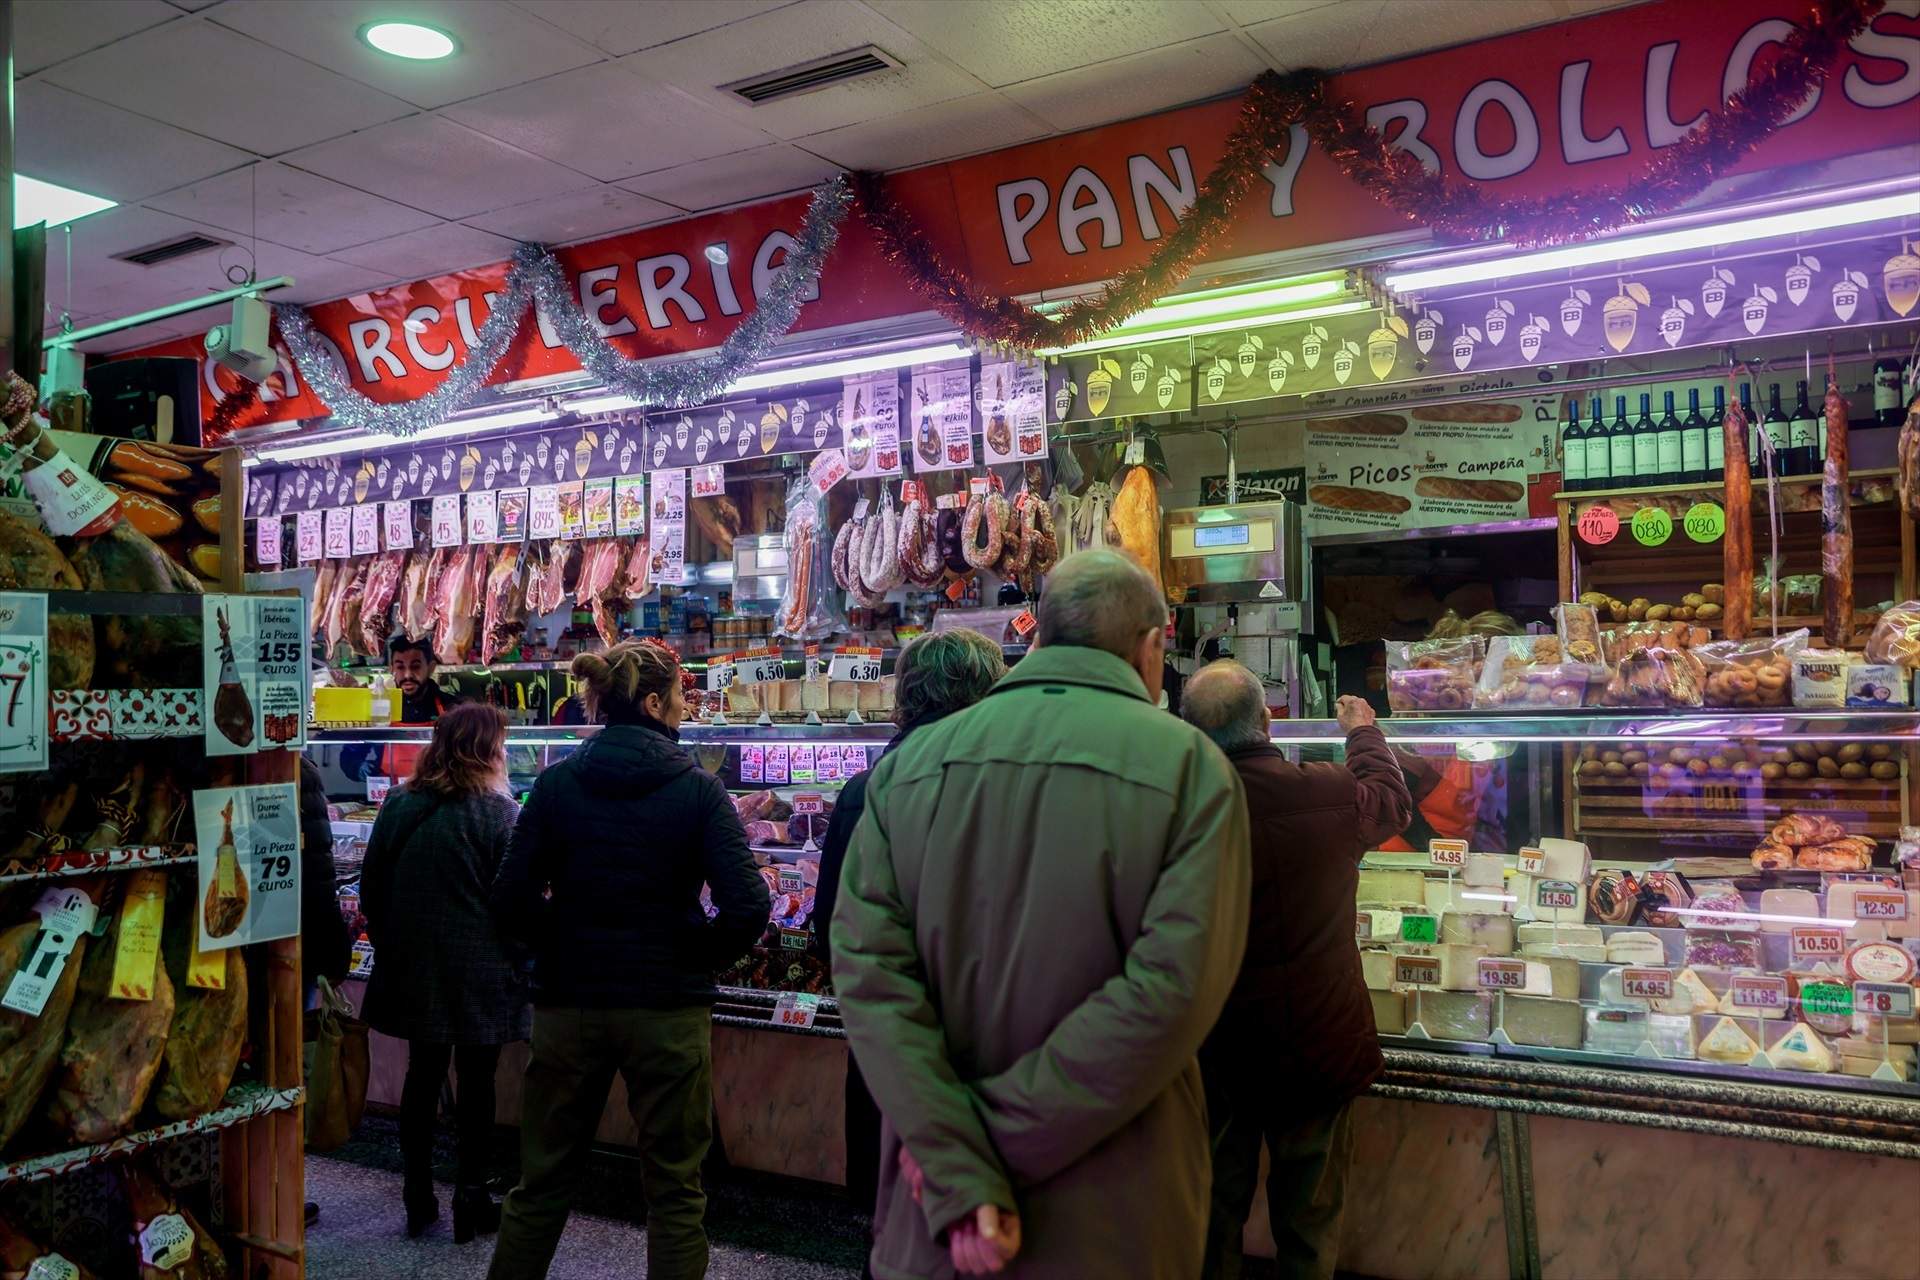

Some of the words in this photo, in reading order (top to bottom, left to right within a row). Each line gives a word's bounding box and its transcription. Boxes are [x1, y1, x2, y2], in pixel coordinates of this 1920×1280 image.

[997, 145, 1197, 264] PAN
[1262, 123, 1309, 217] Y
[1790, 279, 1808, 290] EB
[1705, 292, 1723, 303] EB
[1836, 295, 1855, 306] EB
[1564, 311, 1580, 321] EB
[1746, 310, 1764, 319] EB
[1488, 321, 1504, 331] EB
[1418, 331, 1433, 340] EB
[1523, 338, 1539, 347] EB
[1305, 346, 1319, 355] EB
[1455, 348, 1471, 356] EB
[1241, 355, 1254, 363] EB
[1336, 361, 1350, 370] EB
[1133, 372, 1145, 381] EB
[1271, 370, 1285, 379] EB
[1209, 378, 1223, 387] EB
[1159, 388, 1172, 396] EB
[1350, 463, 1411, 486] Picos
[1458, 457, 1524, 474] Campeña
[390, 523, 401, 542] 18
[437, 523, 451, 540] 15
[473, 519, 485, 535] 12
[330, 533, 344, 549] 22
[357, 530, 370, 545] 20
[264, 614, 290, 624] Ibérico
[260, 630, 271, 640] La
[274, 630, 298, 640] Pieza
[258, 643, 301, 662] 155
[756, 665, 784, 681] 6.50
[850, 665, 878, 680] 6.30
[717, 672, 733, 688] 5.50
[255, 844, 266, 855] La
[270, 842, 296, 854] Pieza
[1433, 850, 1461, 863] 14.95
[261, 856, 291, 879] 79
[1525, 859, 1535, 870] 14
[782, 880, 798, 889] 15.95
[1543, 893, 1571, 905] 11.50
[1864, 902, 1895, 915] 12.50
[1798, 938, 1838, 950] 10.50
[1402, 969, 1412, 980] 17
[1422, 970, 1432, 981] 18
[1484, 971, 1518, 985] 19.95
[1626, 980, 1666, 995] 14.95
[1740, 990, 1778, 1004] 11.95
[1863, 992, 1891, 1011] 18
